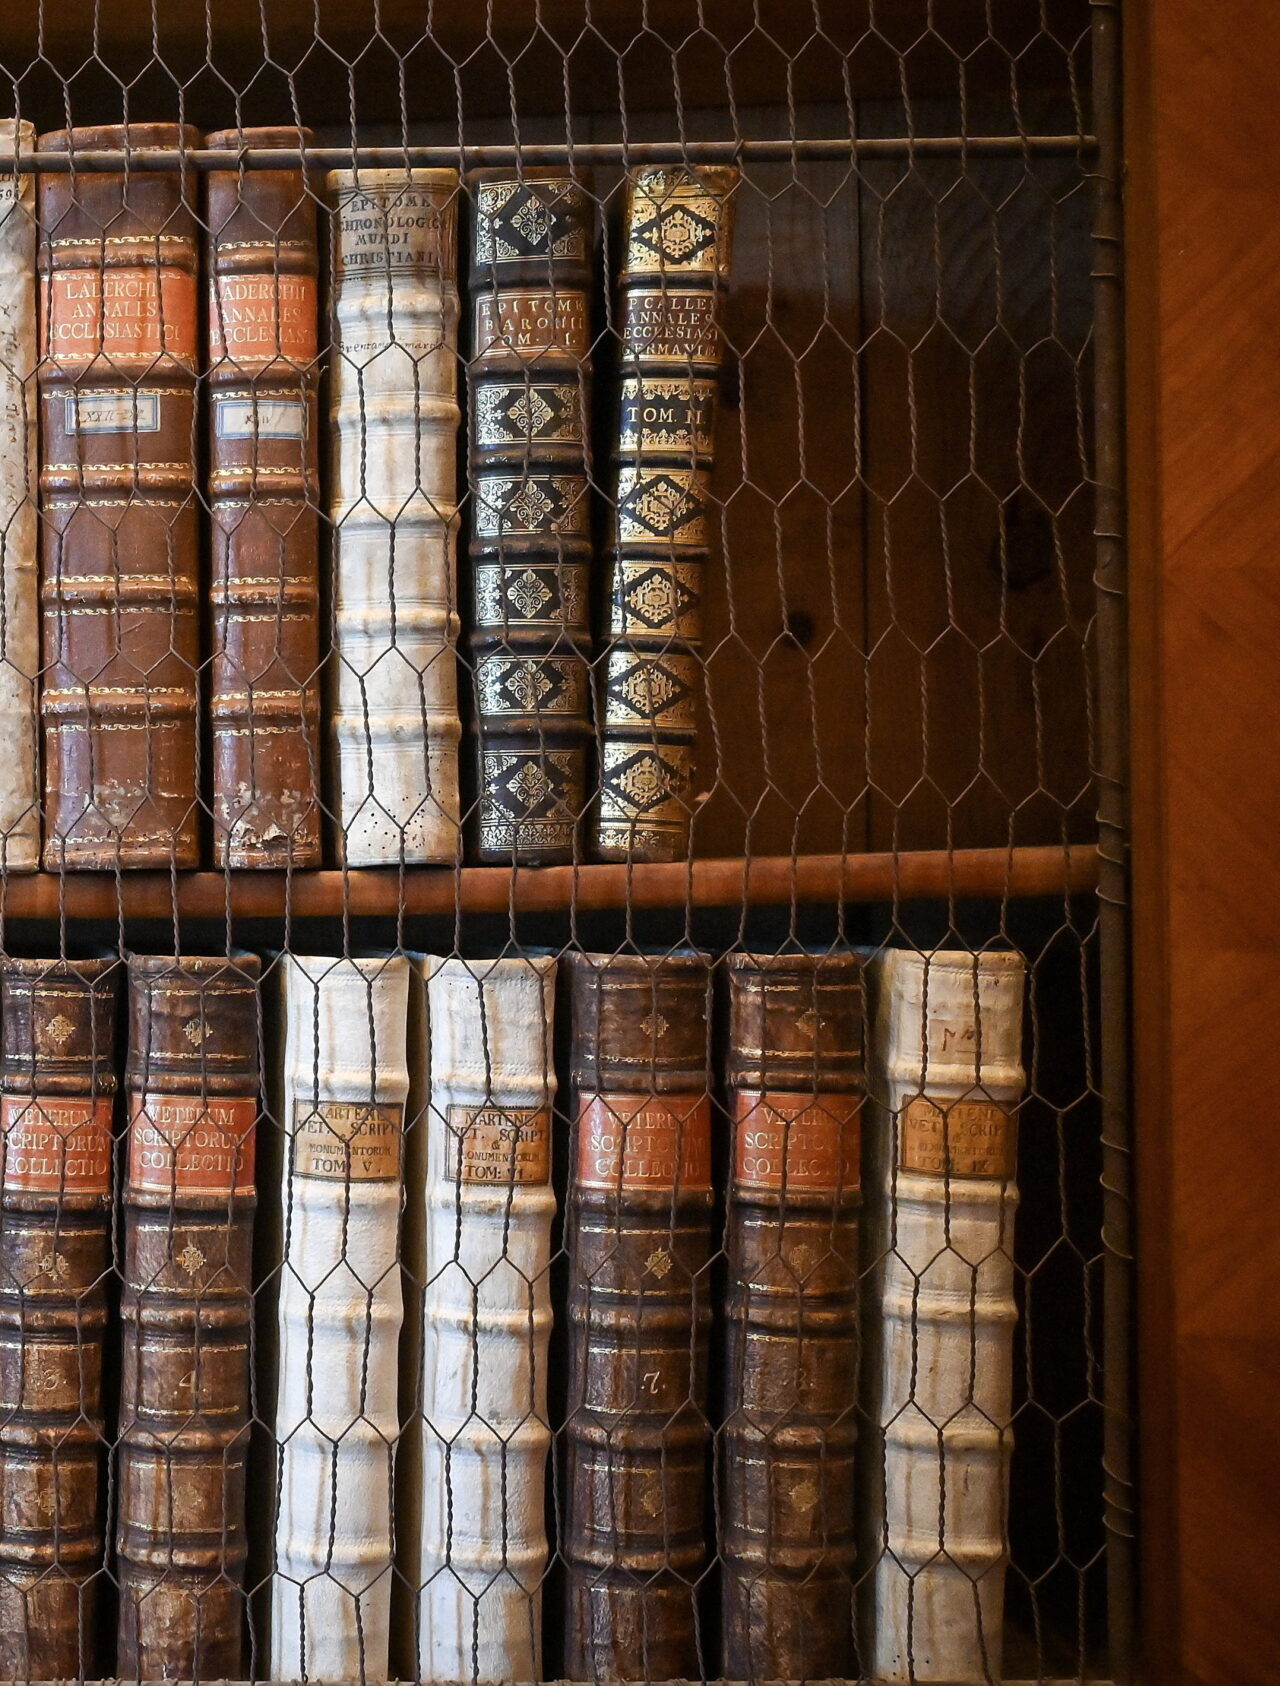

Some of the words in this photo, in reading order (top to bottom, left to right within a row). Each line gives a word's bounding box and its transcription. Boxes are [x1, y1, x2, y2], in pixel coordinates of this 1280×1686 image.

[355, 232, 409, 246] MUNDI
[309, 1143, 392, 1156] MONUMNTORUM
[462, 1151, 540, 1163] ONUMENORUM
[595, 1158, 699, 1178] COLLECIO
